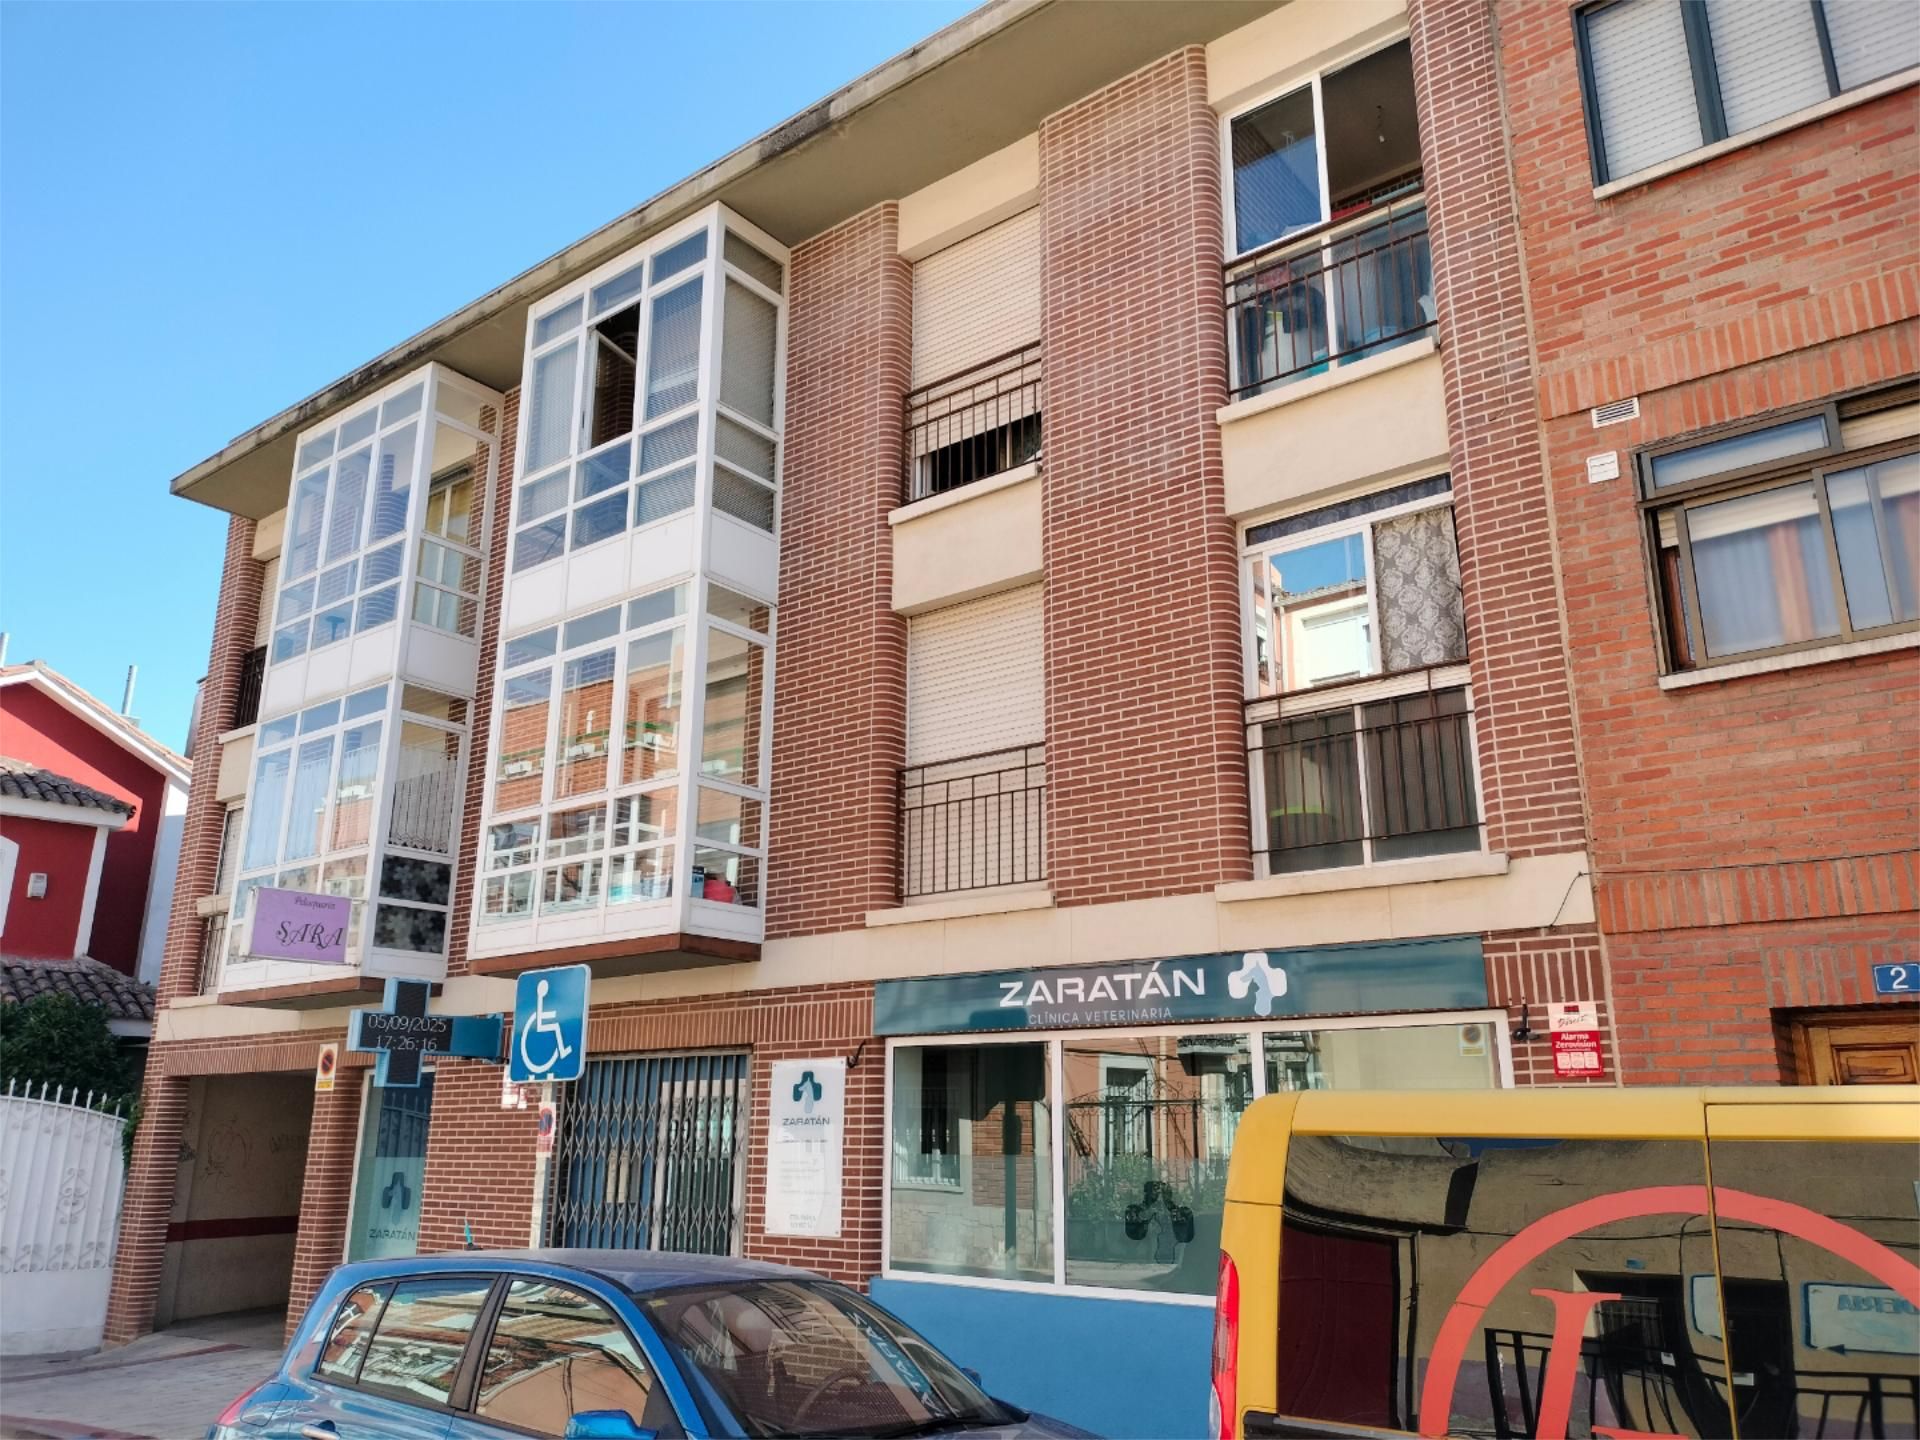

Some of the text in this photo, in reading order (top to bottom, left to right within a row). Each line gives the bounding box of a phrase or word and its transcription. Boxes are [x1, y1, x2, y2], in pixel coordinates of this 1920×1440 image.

[276, 920, 344, 950] SARA
[1000, 962, 1205, 1007] ZARATÁN
[1890, 967, 1909, 989] 2
[368, 1014, 447, 1033] 05/09/2025
[1028, 1007, 1173, 1025] CLÍNICA VETERINARIA
[376, 1035, 438, 1051] 17:26:16
[1561, 1033, 1590, 1041] Alarma
